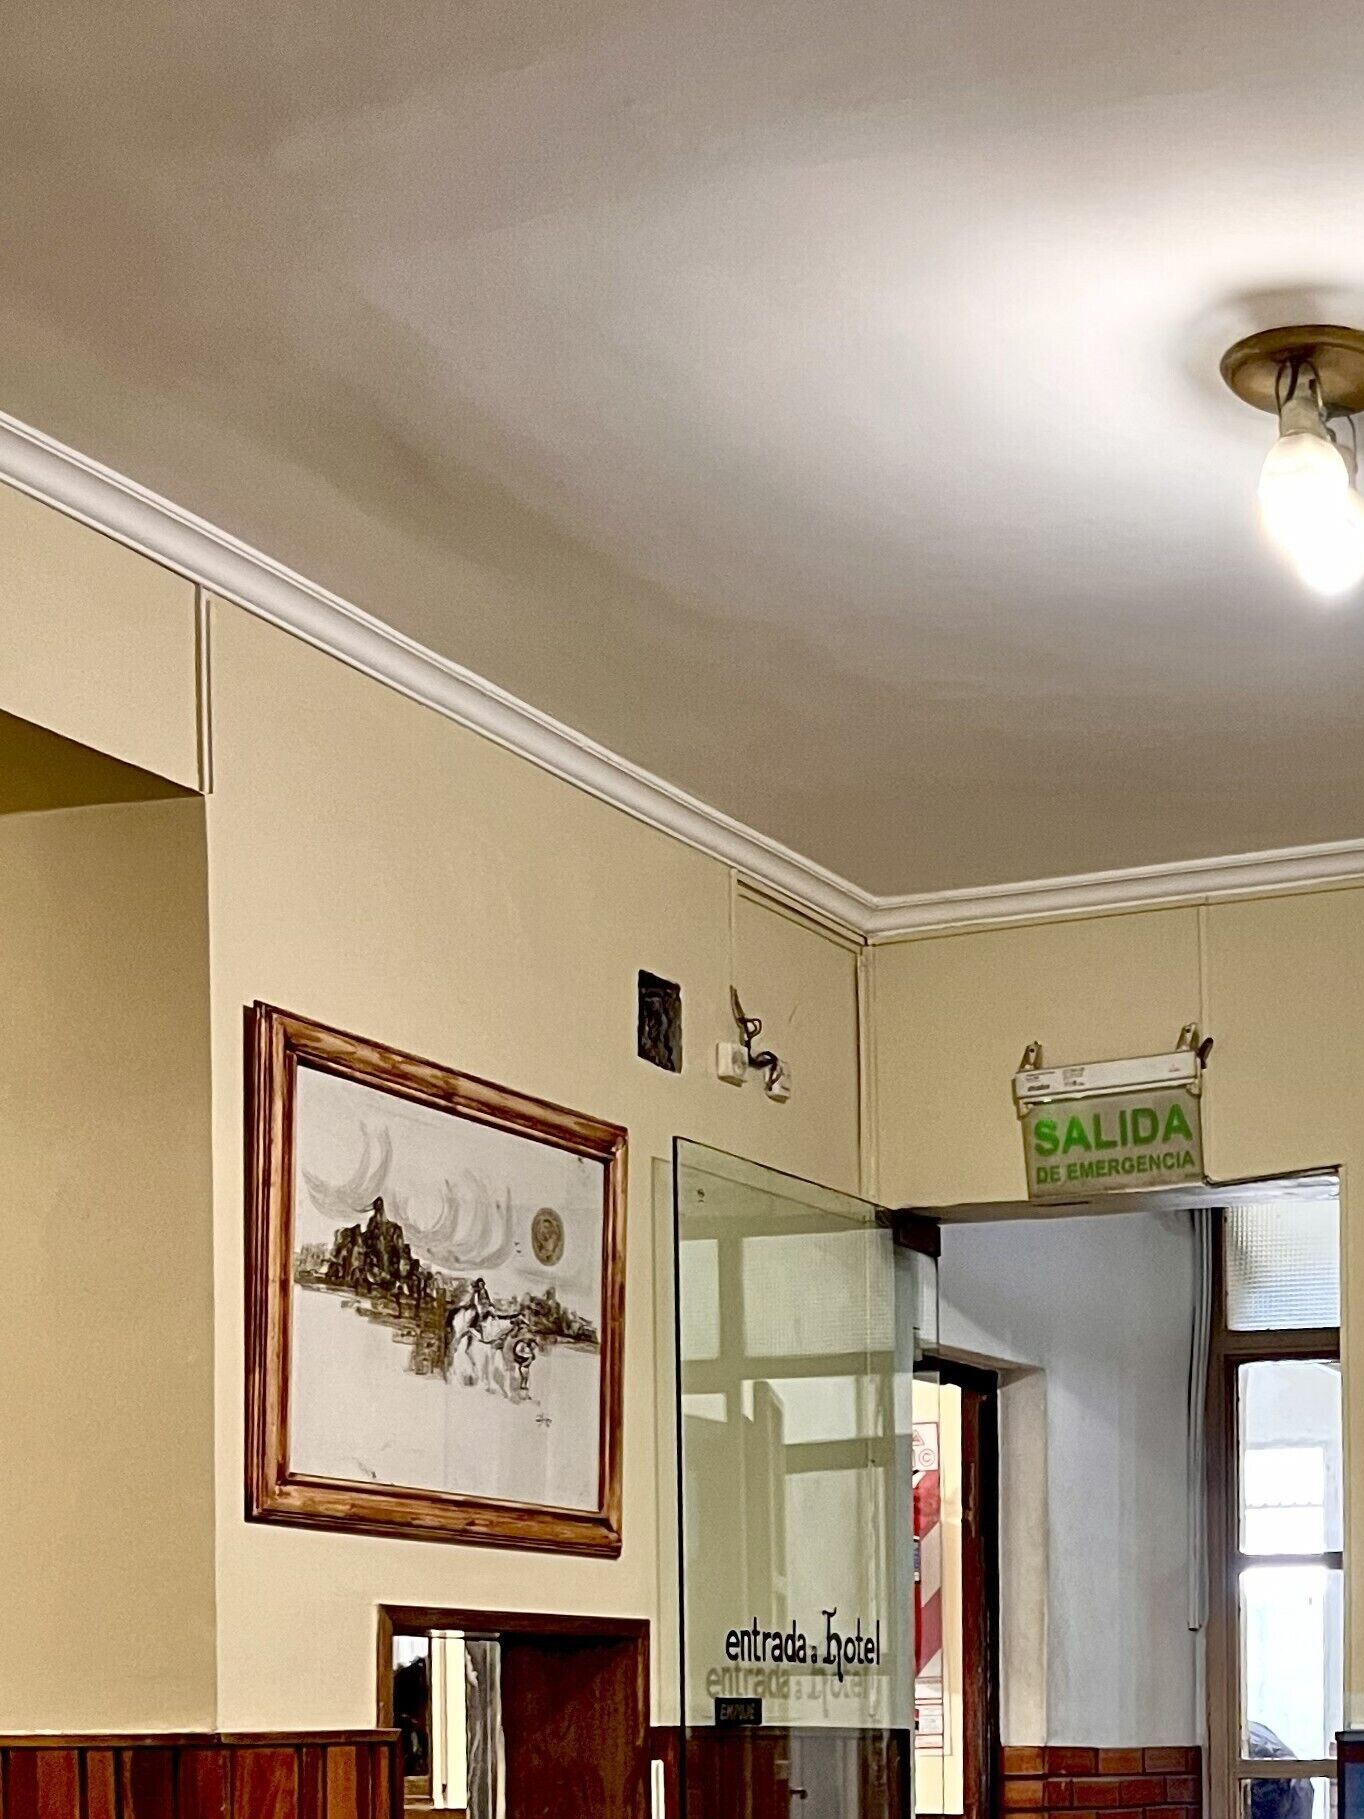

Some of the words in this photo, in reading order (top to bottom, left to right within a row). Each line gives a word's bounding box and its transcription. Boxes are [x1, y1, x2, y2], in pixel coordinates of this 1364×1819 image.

[1033, 1103, 1193, 1158] SALIDA
[1036, 1164, 1062, 1185] DE
[1066, 1150, 1196, 1181] EMERGENCIA
[725, 1616, 807, 1664] entrada
[822, 1606, 880, 1683] hotel
